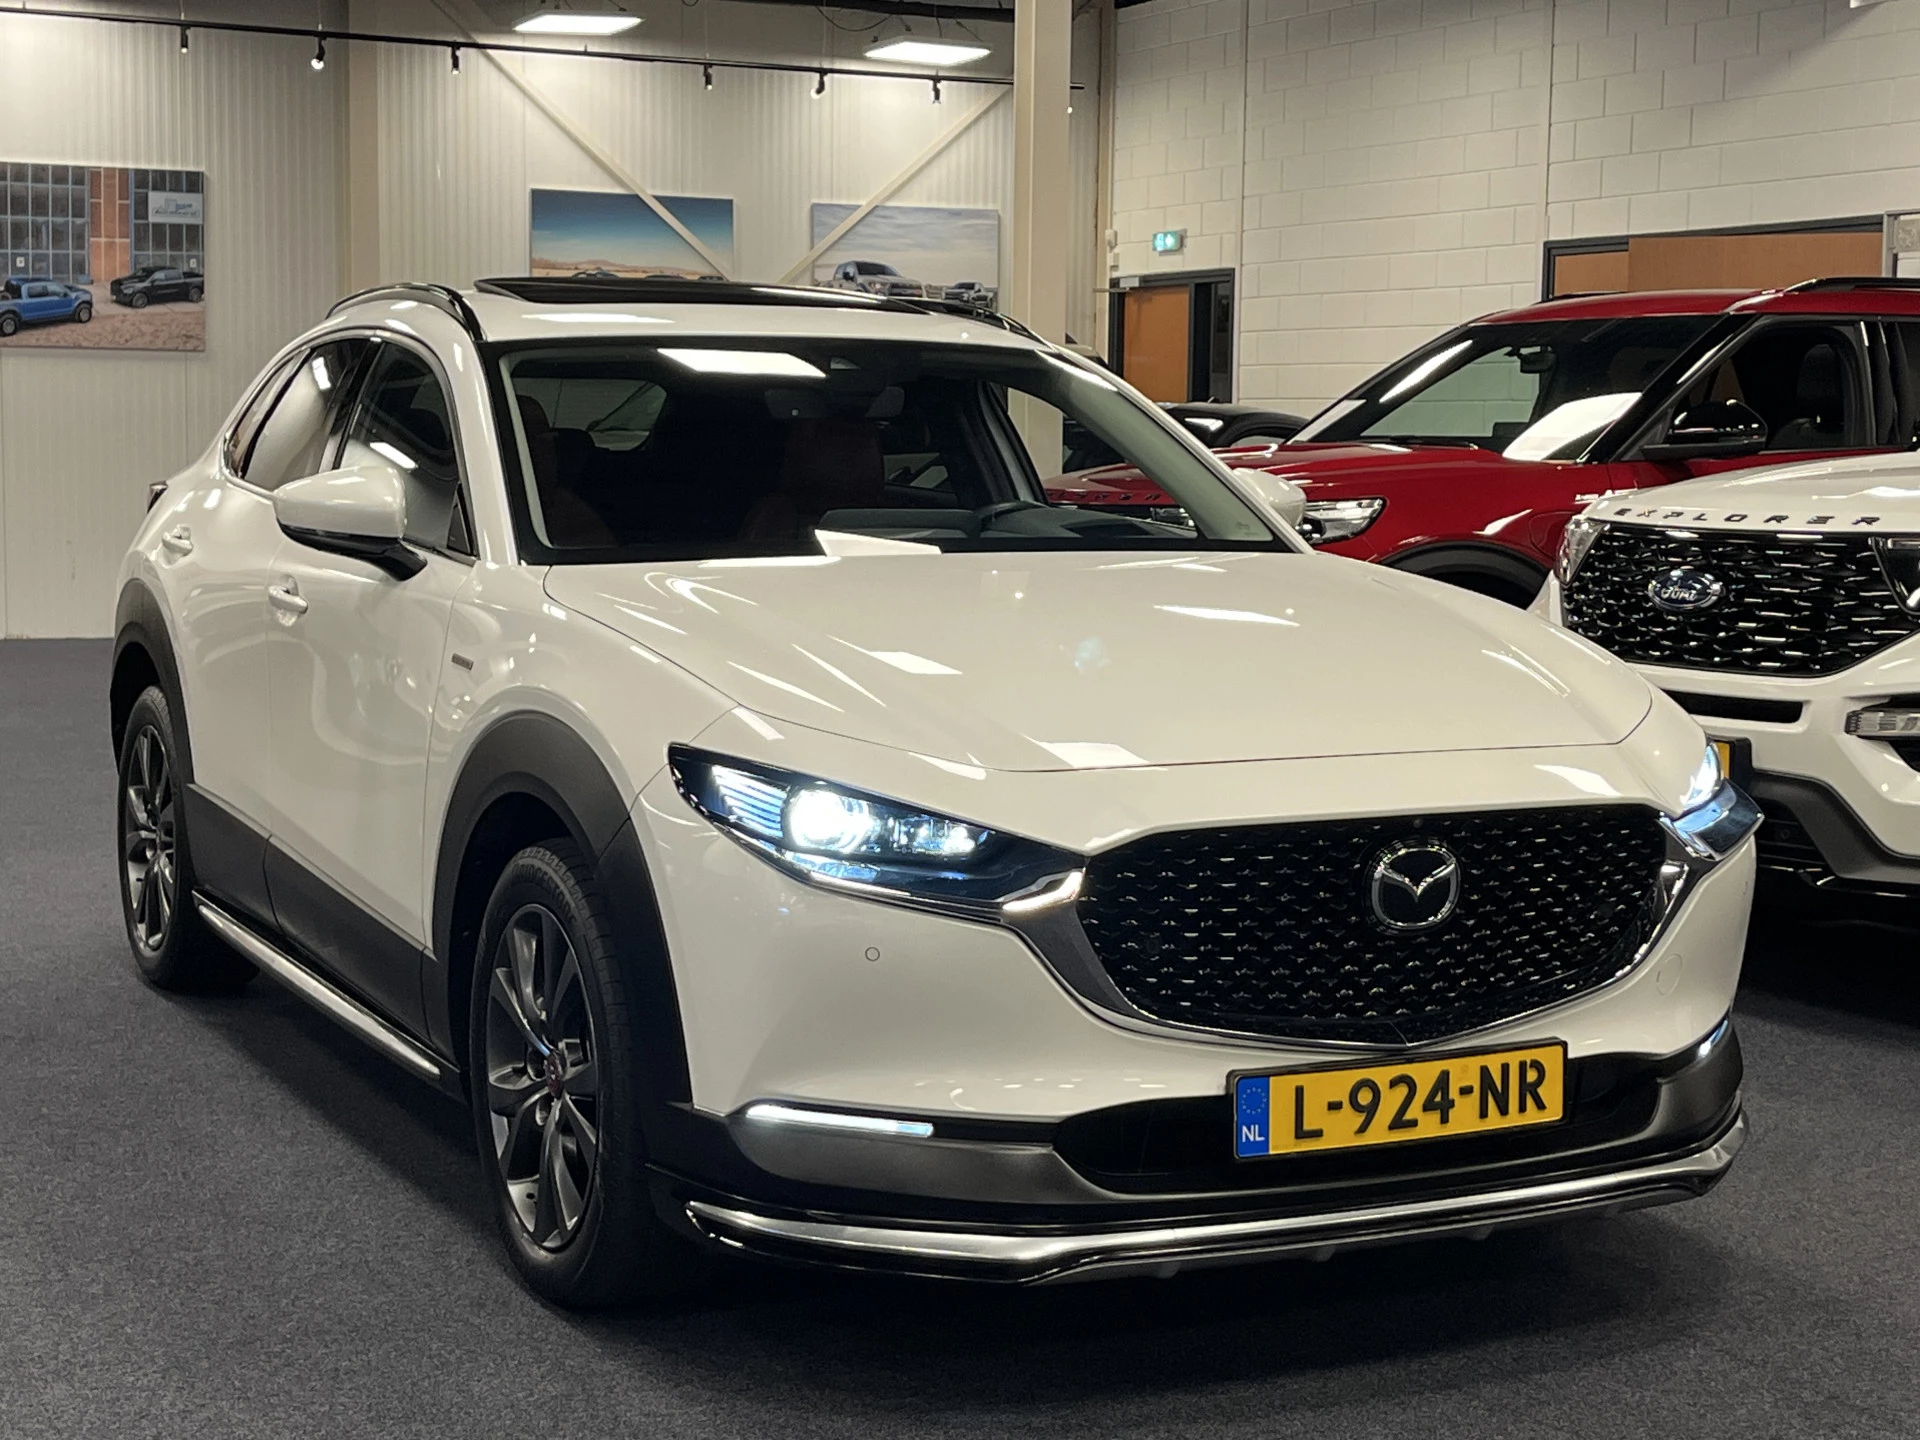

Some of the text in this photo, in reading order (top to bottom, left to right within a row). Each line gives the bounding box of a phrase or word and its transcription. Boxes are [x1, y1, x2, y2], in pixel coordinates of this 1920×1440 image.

[1613, 508, 1881, 526] EXPLORER
[1660, 581, 1700, 601] Ford
[1294, 1058, 1548, 1140] L-924-NR
[1241, 1124, 1266, 1143] NL
